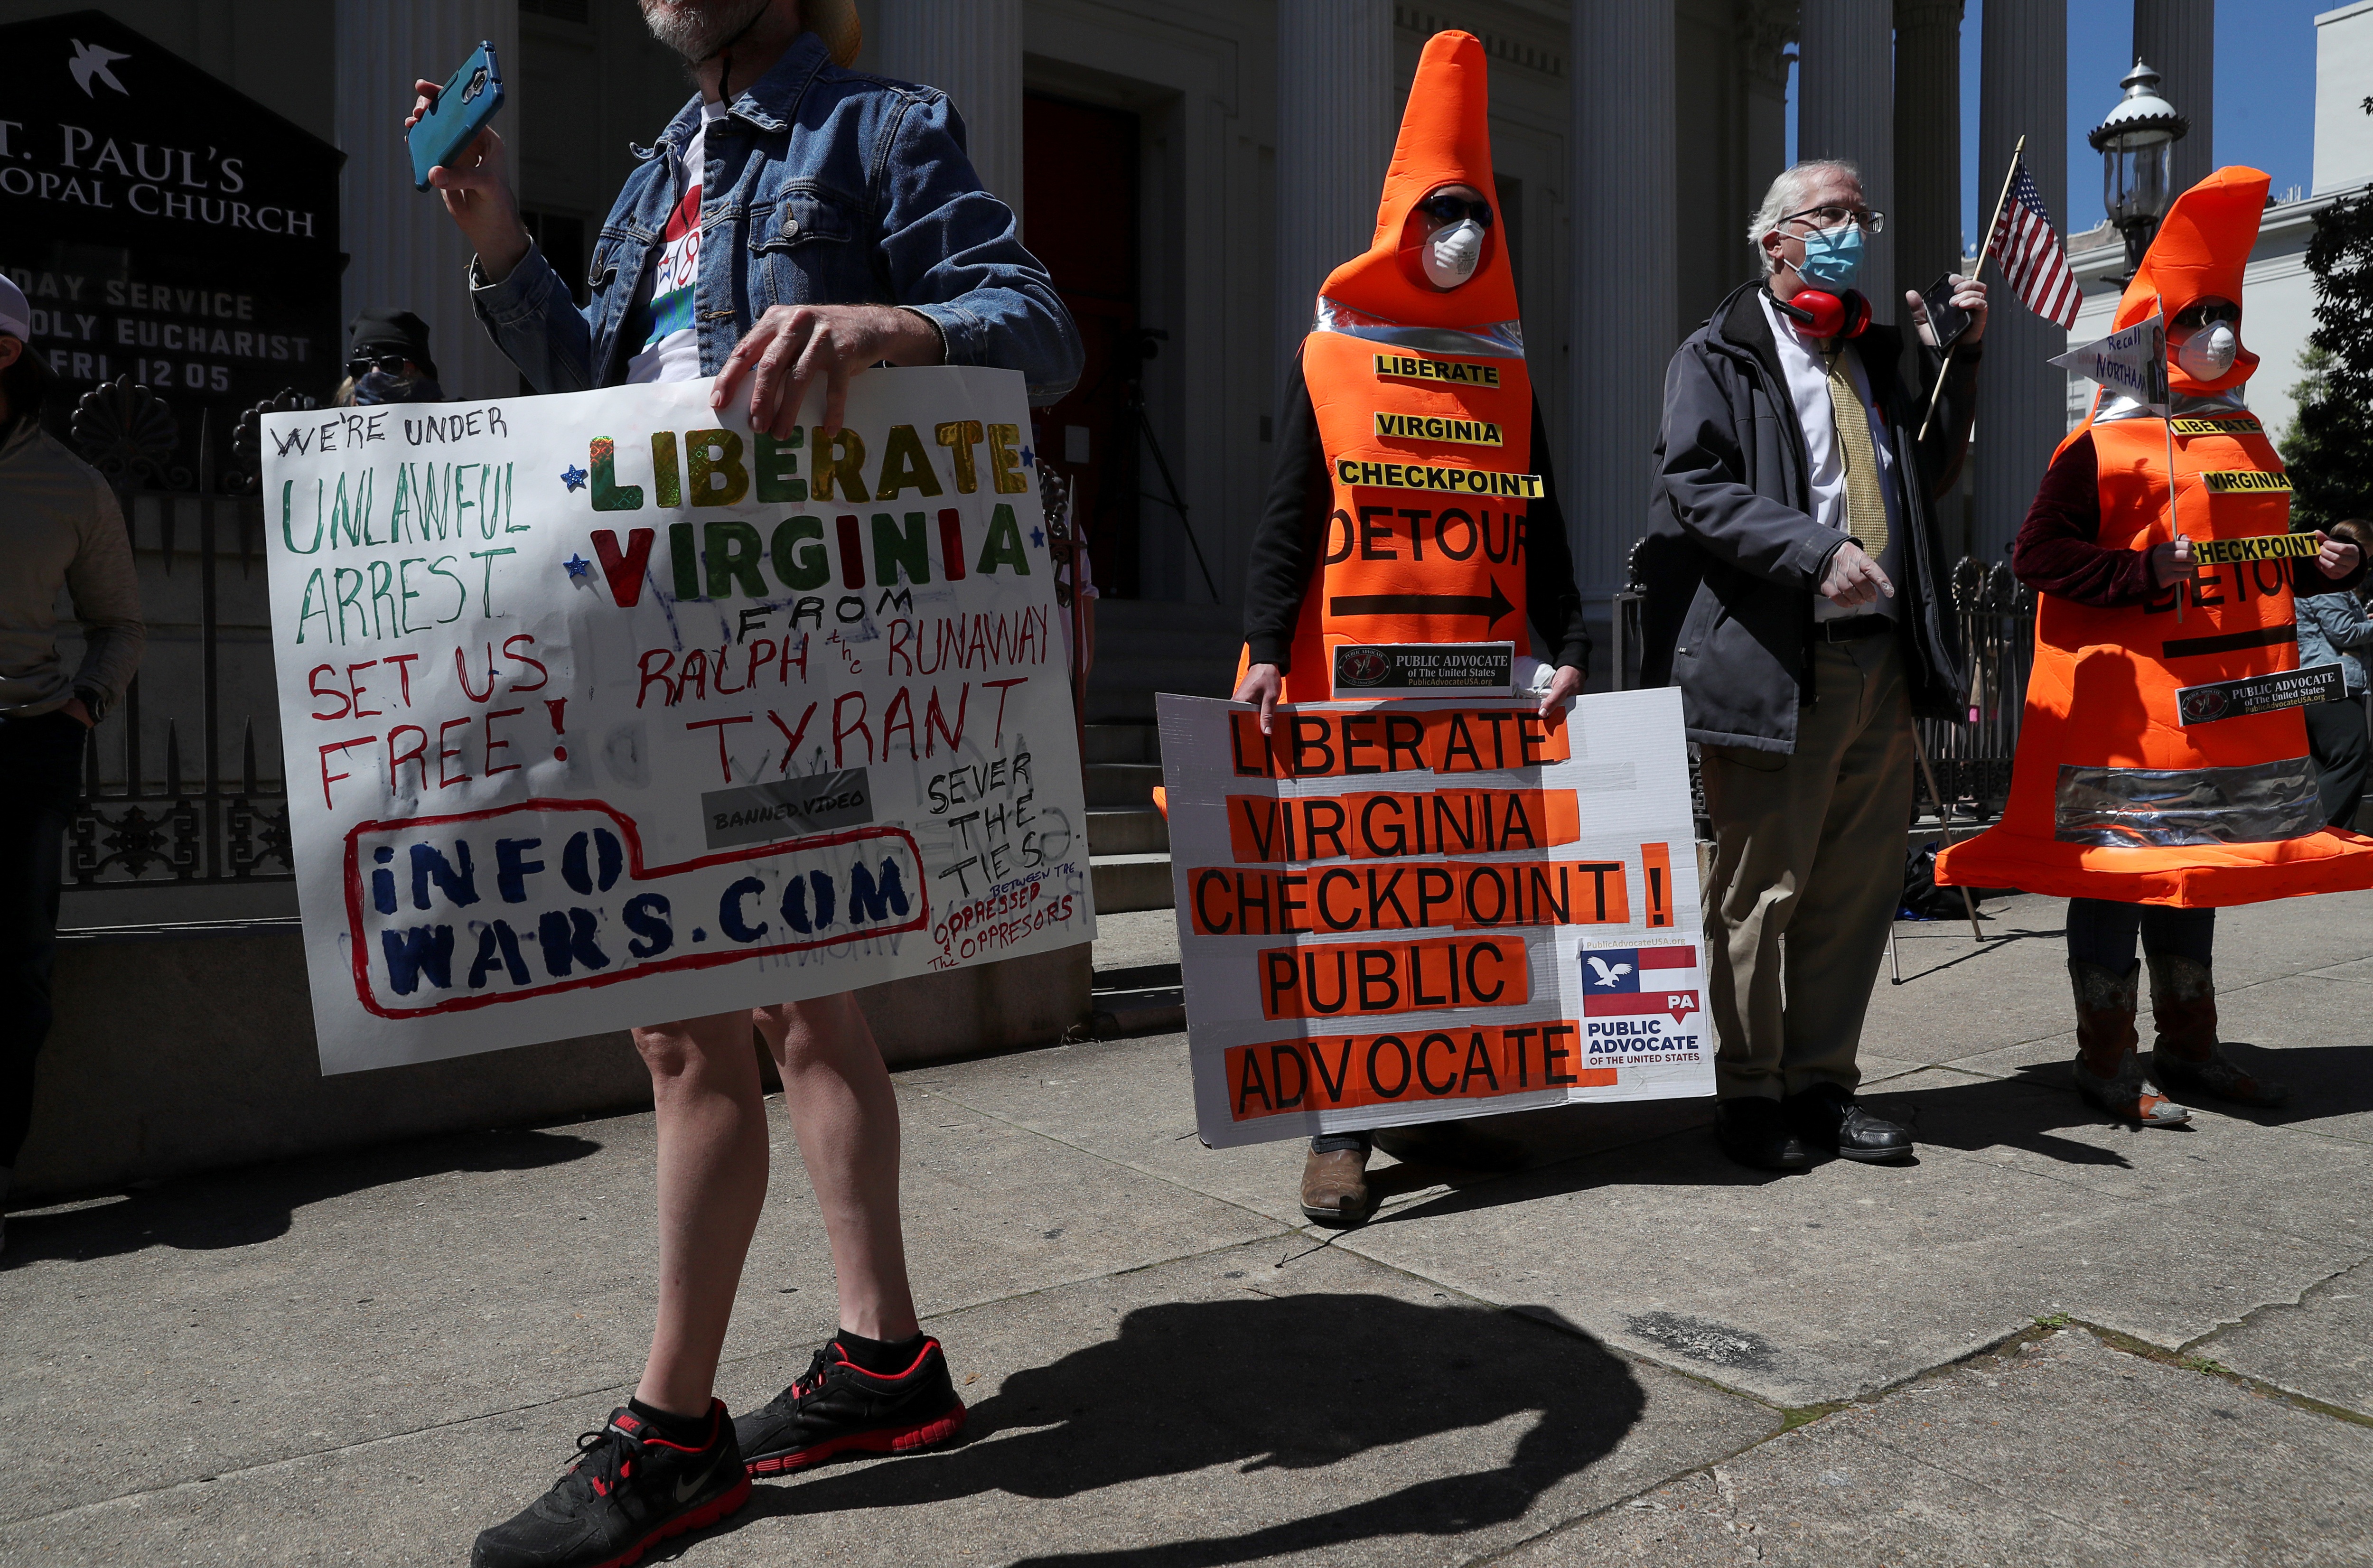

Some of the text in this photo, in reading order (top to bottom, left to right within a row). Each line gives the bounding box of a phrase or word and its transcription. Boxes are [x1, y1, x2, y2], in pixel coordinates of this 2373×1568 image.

[58, 124, 244, 193] PAUL'S
[0, 168, 315, 237] OPAL CHURCH
[0, 266, 253, 320] DAY SERVICE
[30, 309, 310, 362] OLY EUCHARIST
[2106, 327, 2140, 351] Recall
[50, 349, 107, 380] FRI
[1377, 355, 1498, 383] LIBERATE
[2096, 353, 2147, 397] NORTHAM
[270, 407, 507, 457] WE'RE UNDER
[1377, 414, 1501, 443] VIRGINIA
[2171, 419, 2261, 432] LIBERATE
[589, 420, 1028, 511] LIBERATE
[1338, 460, 1539, 497] CHECKPOINT
[2205, 473, 2291, 489] VIRGINIA
[283, 462, 530, 554] UNLAWFUL
[589, 504, 1030, 607] VIRGINIA
[1323, 506, 1526, 566] DETOUR
[297, 547, 516, 645] ARREST
[737, 588, 914, 644] FROM
[308, 634, 548, 720] SET US
[636, 633, 810, 709] RALPH
[888, 604, 1048, 677] RUNAWAY
[1396, 655, 1508, 667] PUBLIC ADVOCATE
[1408, 668, 1495, 677] of The United States
[1408, 678, 1493, 686] PublicAdvocateUSA.org
[2233, 672, 2335, 700] PUBLIC ADVOCATE
[2245, 686, 2325, 706] of The United States
[2245, 694, 2325, 713] PublicAdvocateUSA.org
[319, 697, 568, 810] FREE!
[686, 677, 1029, 784] TYRANT
[1230, 713, 1554, 777] LIBERATE
[928, 752, 1031, 814] SEVER
[713, 790, 865, 830] BANNED.VIDEO
[948, 793, 1036, 850] THE
[1243, 793, 1536, 861] VIRGINIA
[938, 831, 1042, 897] TIES
[990, 868, 1050, 897] BETWEEN
[382, 856, 910, 995] WARS.COM
[935, 881, 1040, 944] OPPRESSED
[1587, 938, 1685, 949] PublicAdvocateUSA.org
[1267, 942, 1505, 1015] PUBLIC
[1668, 995, 1695, 1009] PA
[1588, 1020, 1661, 1037] PUBLIC
[1589, 1036, 1699, 1054] ADVOCATE
[1238, 1026, 1578, 1113] ADVOCATE
[1590, 1053, 1700, 1065] OF THE UNITED STATES
[615, 1415, 640, 1432] NIKE
